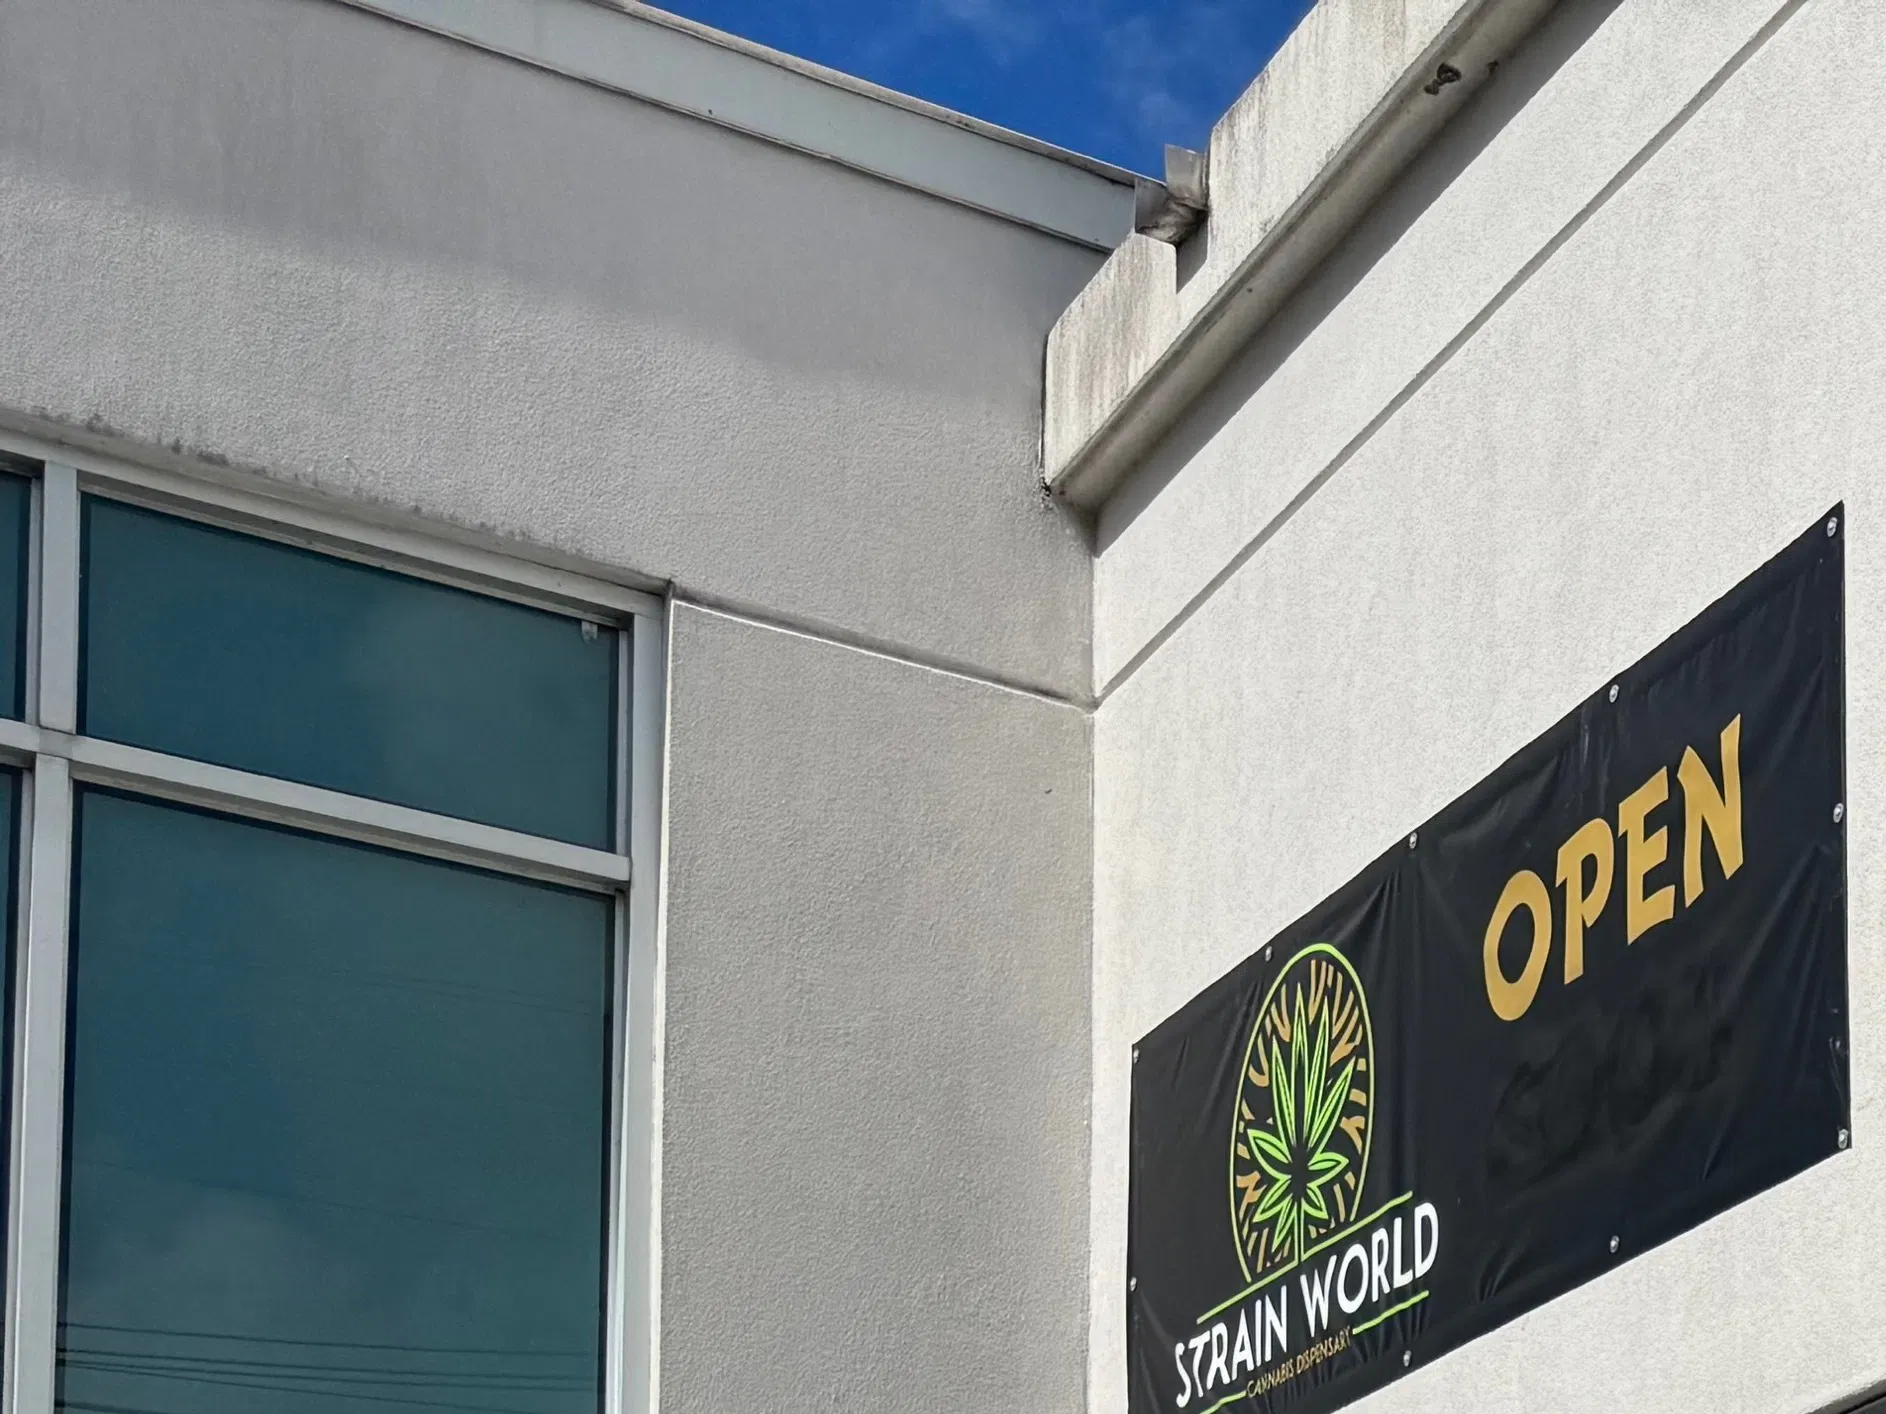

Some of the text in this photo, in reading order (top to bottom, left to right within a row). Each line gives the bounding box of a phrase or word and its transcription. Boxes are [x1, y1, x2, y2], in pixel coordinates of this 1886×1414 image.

[1482, 713, 1743, 1020] OPEN
[1174, 1202, 1439, 1408] STRAIN WORLD
